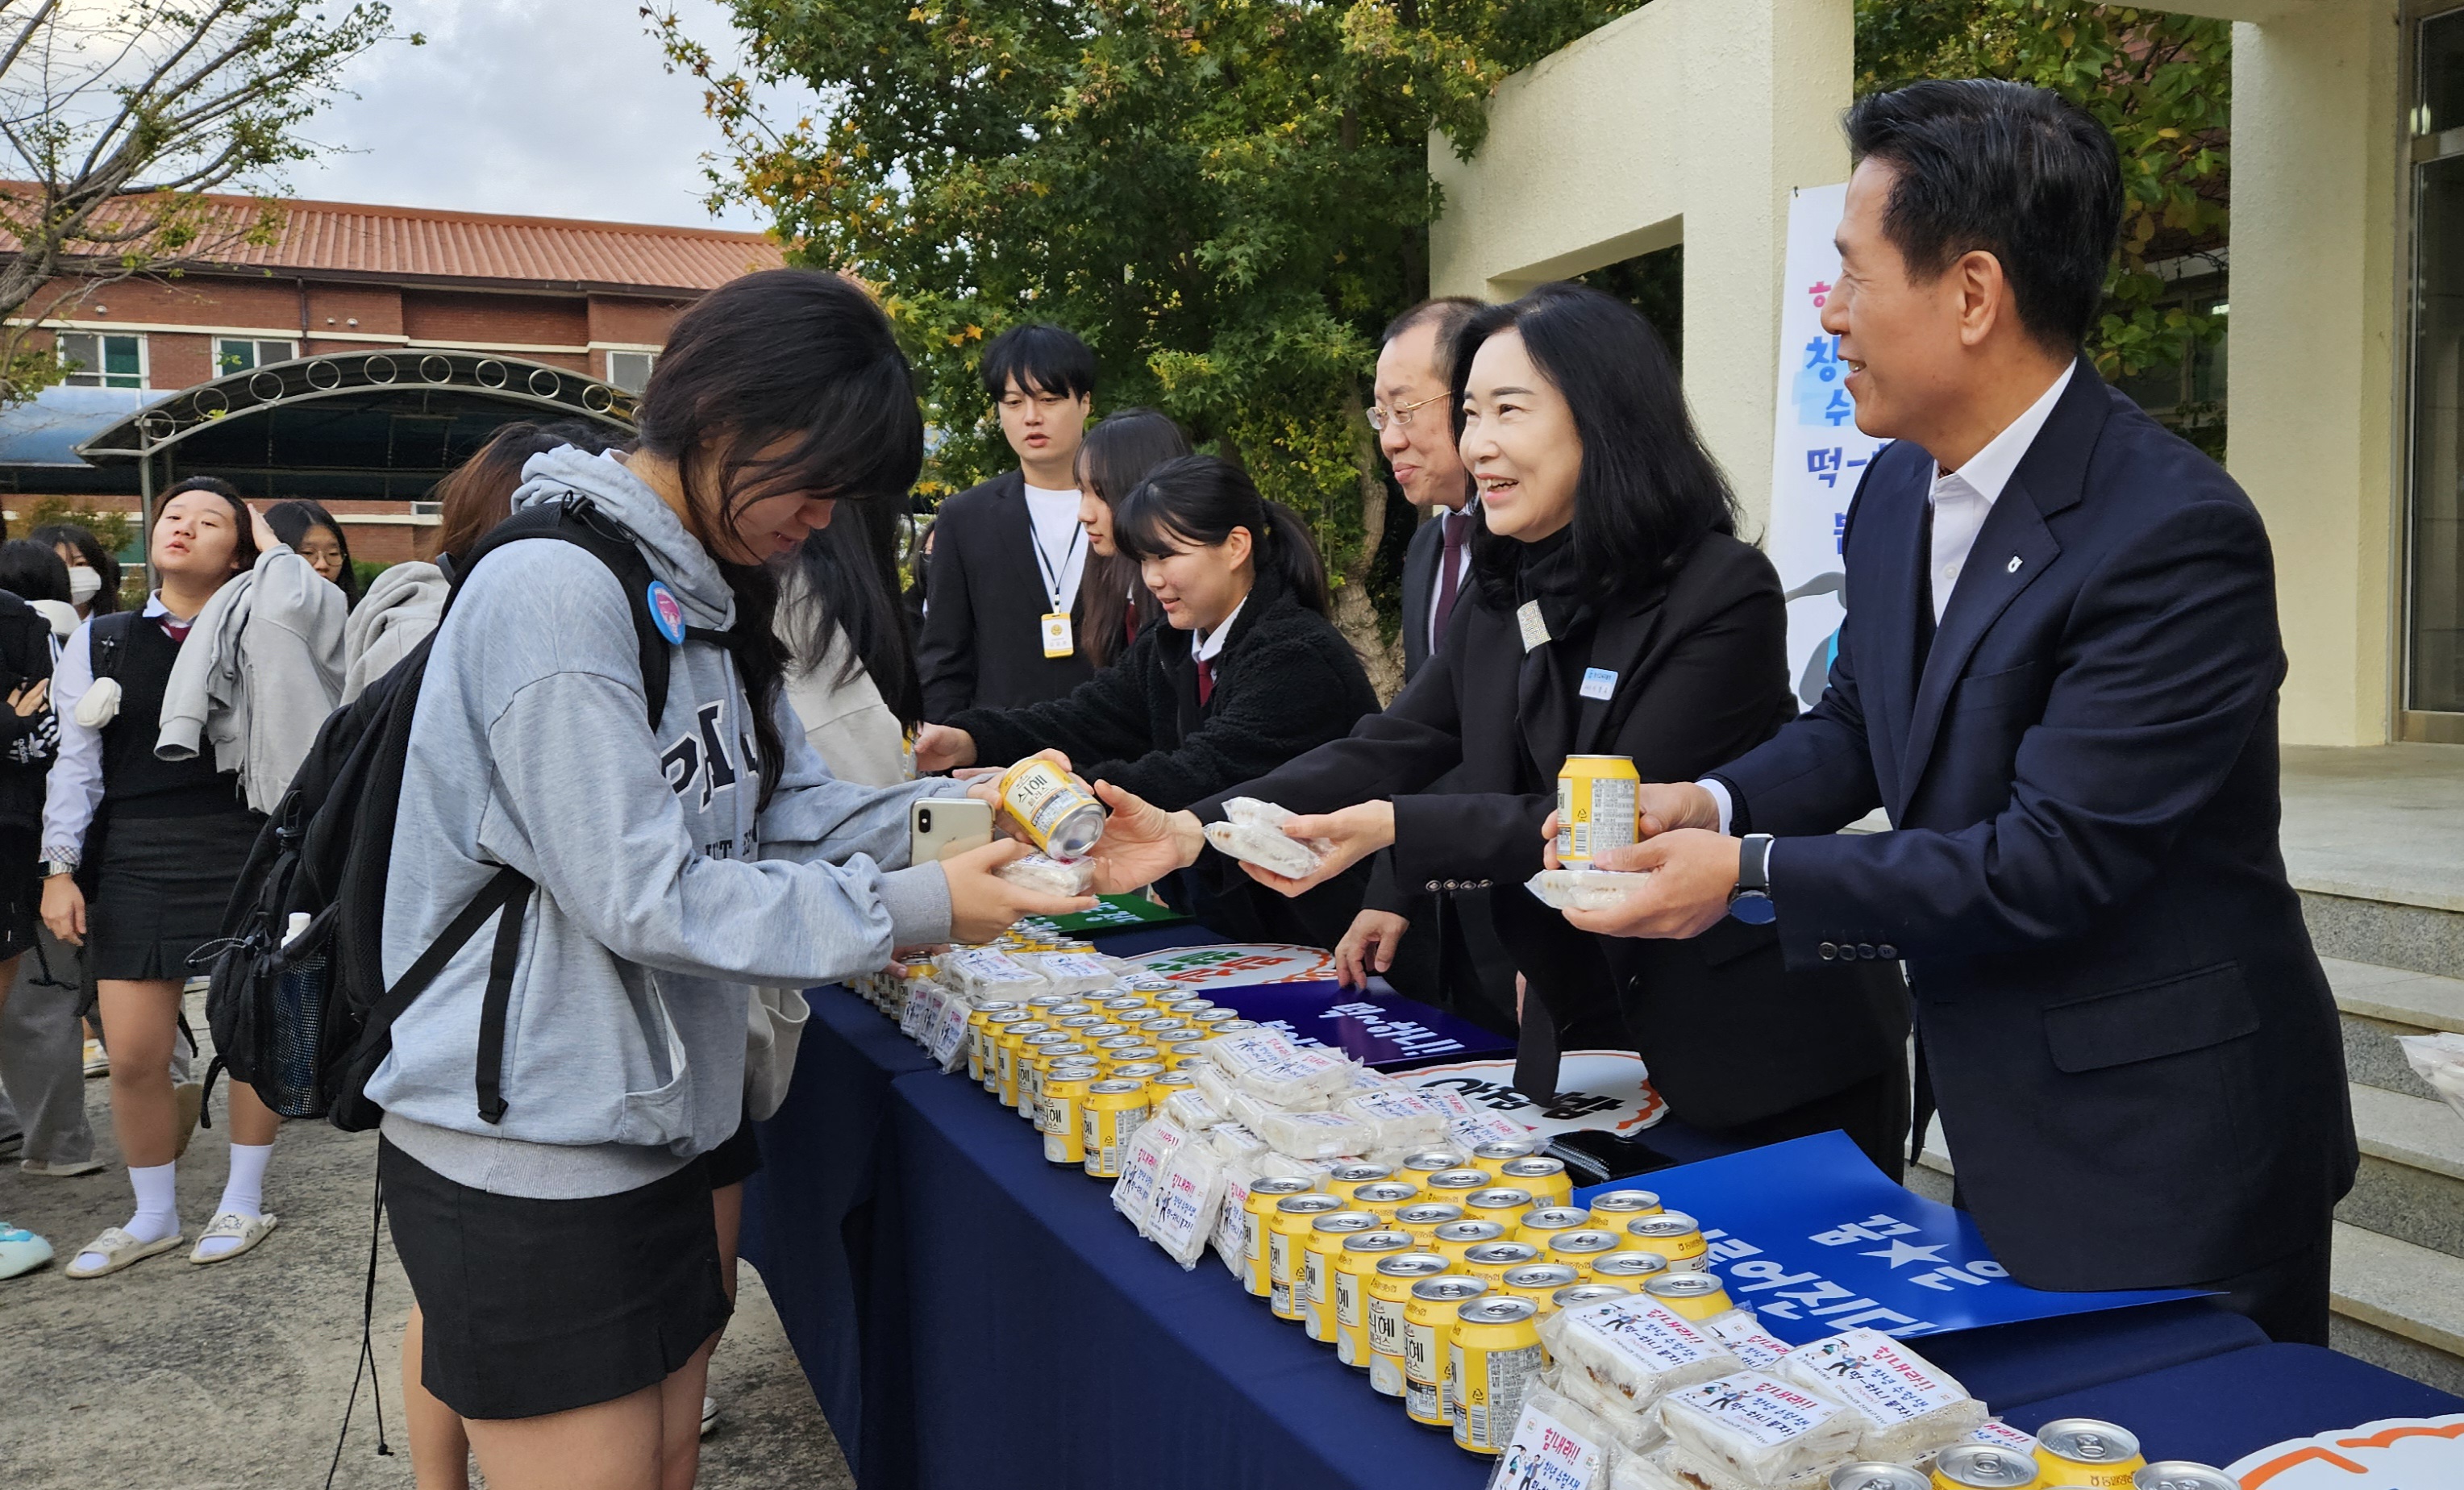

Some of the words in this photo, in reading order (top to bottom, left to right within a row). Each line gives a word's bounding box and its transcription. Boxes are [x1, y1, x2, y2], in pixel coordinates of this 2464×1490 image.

[1646, 1309, 1704, 1344] 힘내라!!
[1871, 1368, 1896, 1385] 창녕
[1872, 1346, 1937, 1392] 힘내라!!
[1754, 1382, 1818, 1411] 힘내라!!
[1542, 1427, 1581, 1466] 힘내라!!
